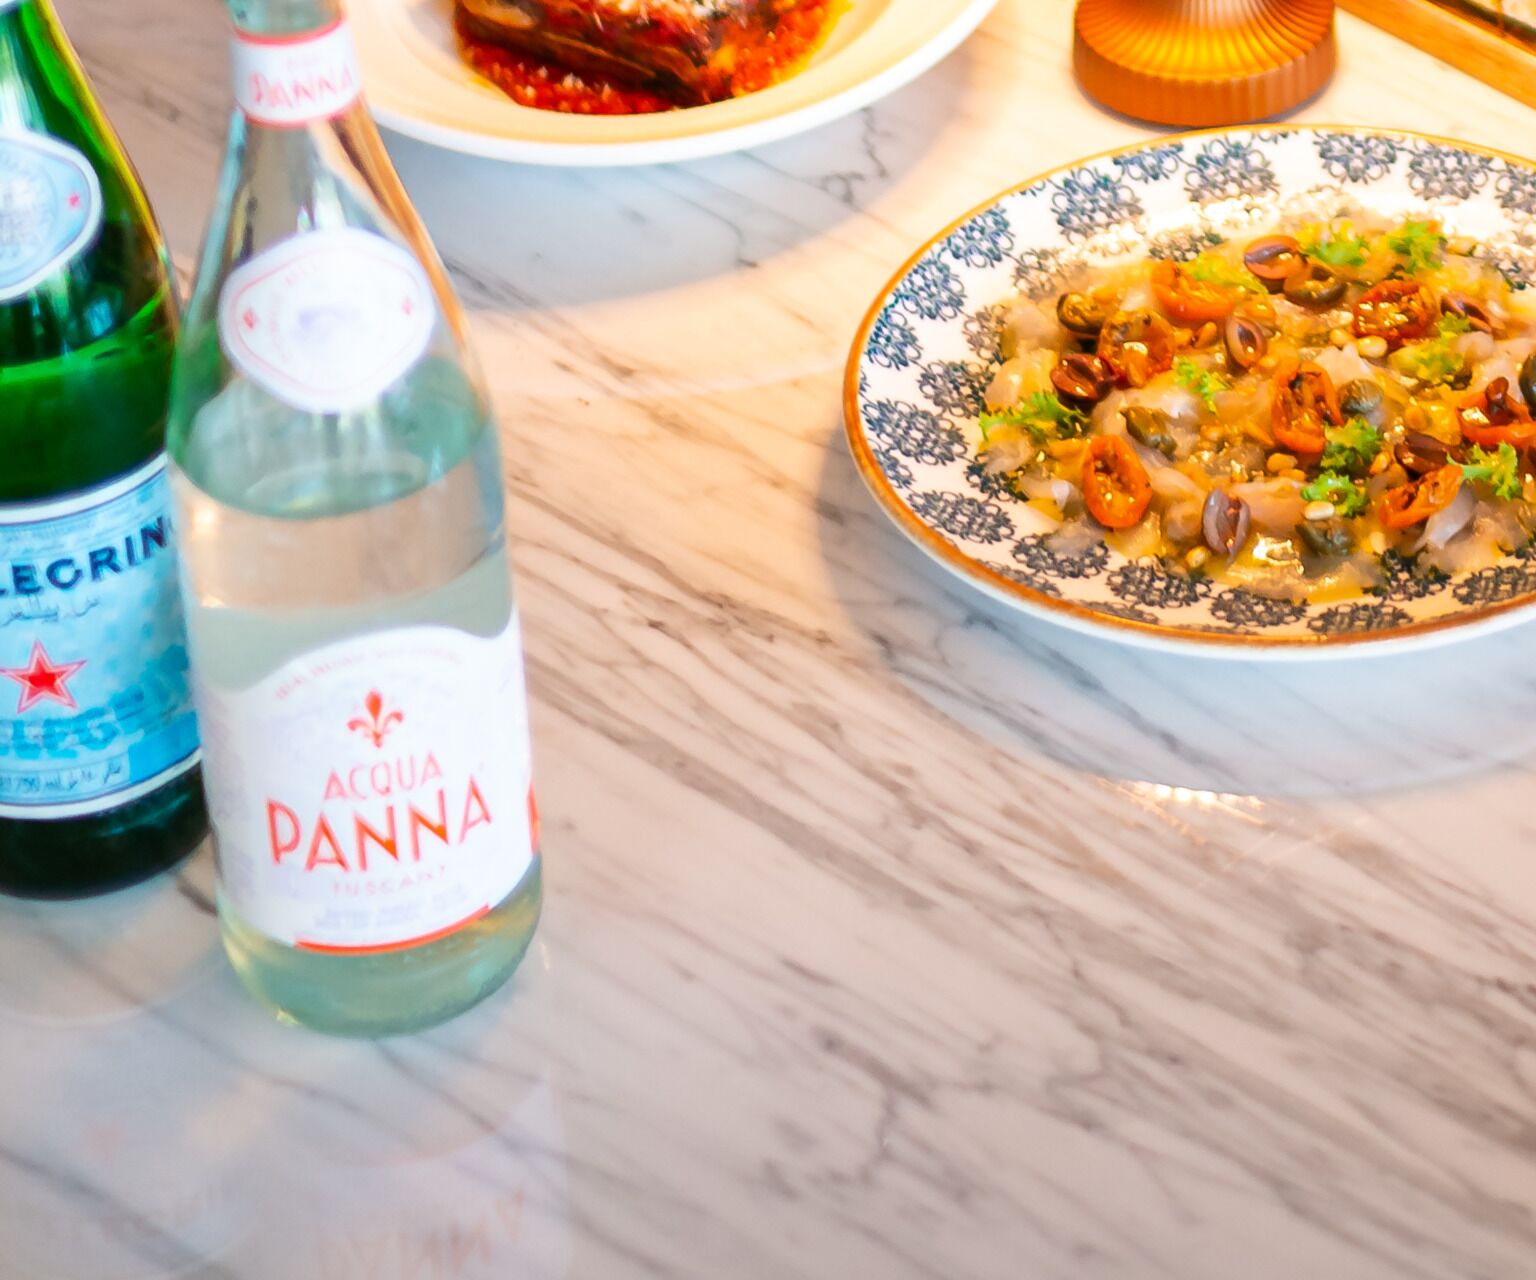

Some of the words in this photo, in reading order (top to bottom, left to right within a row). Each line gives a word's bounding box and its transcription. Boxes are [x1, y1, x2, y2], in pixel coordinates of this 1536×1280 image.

[0, 515, 174, 597] EGRIN
[323, 750, 443, 802] ACQUA
[265, 773, 492, 873] PANNA
